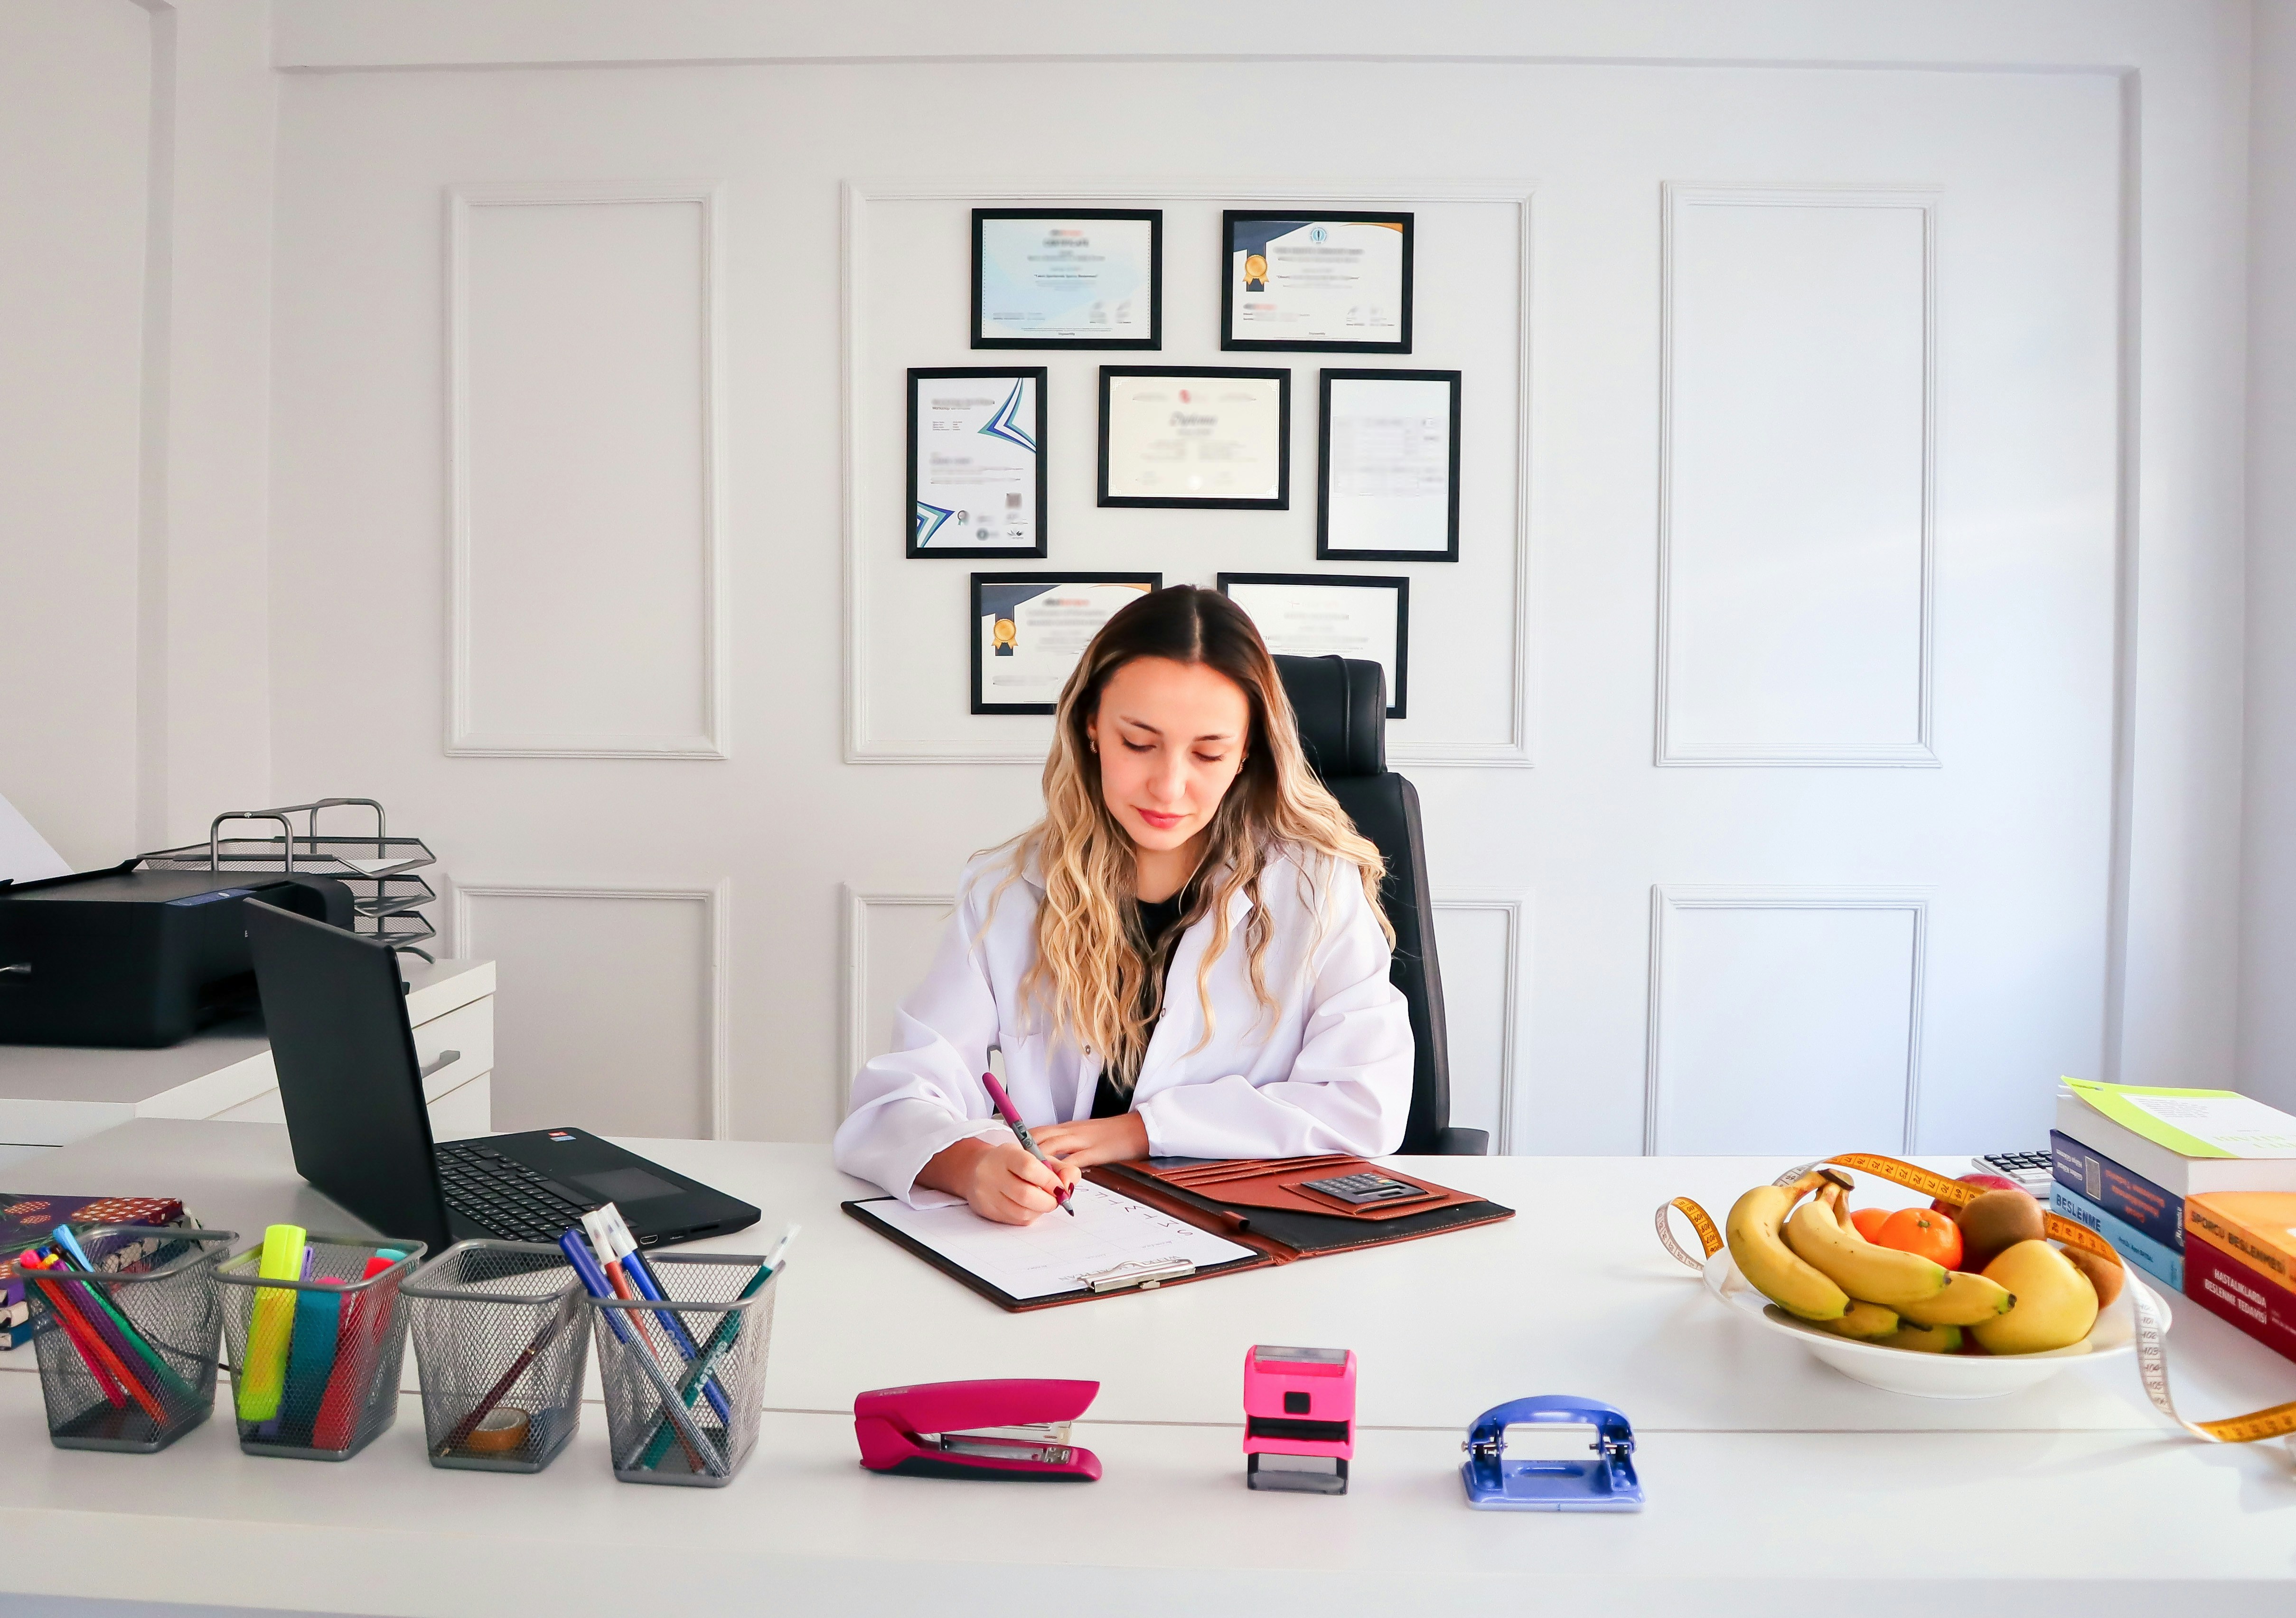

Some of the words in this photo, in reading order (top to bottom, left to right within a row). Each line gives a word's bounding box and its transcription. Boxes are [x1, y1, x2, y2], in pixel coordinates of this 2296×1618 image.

[1872, 1161, 1880, 1169] 75
[1885, 1165, 1893, 1174] 74
[1900, 1169, 1908, 1179] 73
[1913, 1174, 1922, 1185] 72
[1928, 1180, 1935, 1188] 71
[1941, 1184, 1949, 1194] 70
[1694, 1213, 1703, 1222] 109
[2056, 1193, 2101, 1233] BESLENME
[1701, 1223, 1710, 1233] 108
[1706, 1235, 1715, 1244] 107
[2143, 1331, 2157, 1339] 102
[2144, 1347, 2159, 1355] 103
